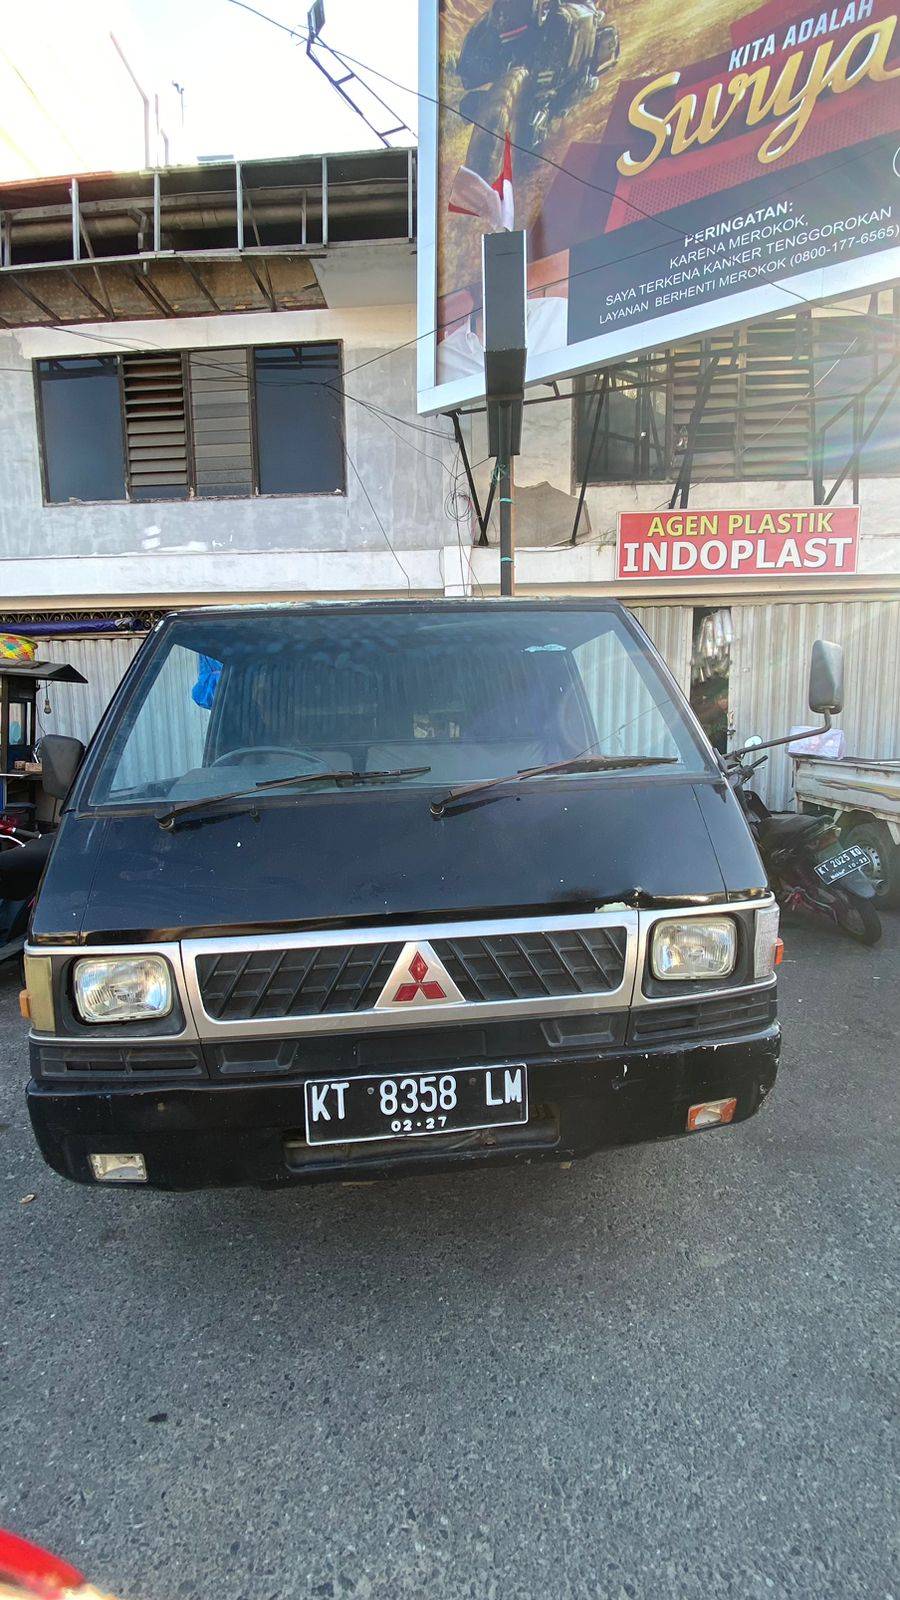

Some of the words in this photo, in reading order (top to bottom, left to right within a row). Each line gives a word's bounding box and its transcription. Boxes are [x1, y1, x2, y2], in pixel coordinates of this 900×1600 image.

[728, 34, 776, 72] KITA
[782, 0, 873, 50] ADALAH
[616, 15, 900, 176] Surya
[669, 241, 726, 270] KARENA
[728, 214, 809, 250] MEROKOK,
[684, 200, 793, 247] PERINGATAN:
[599, 300, 649, 325] LAYANAN
[655, 279, 716, 308] BERHENTI
[719, 257, 786, 288] MEROKOK
[790, 224, 900, 268] (0800-177-6565)
[605, 287, 636, 307] SAYA
[639, 267, 700, 296] TERKENA
[703, 246, 762, 276] KANKER
[766, 206, 892, 255] TENGGOROKAN
[647, 515, 719, 537] AGEN
[728, 512, 833, 535] PLASTIK
[622, 537, 853, 573] INDOPLAST
[818, 864, 829, 875] KT
[830, 853, 851, 868] 2025
[311, 1083, 350, 1122] KT
[379, 1075, 457, 1116] 8358
[485, 1069, 523, 1106] LM
